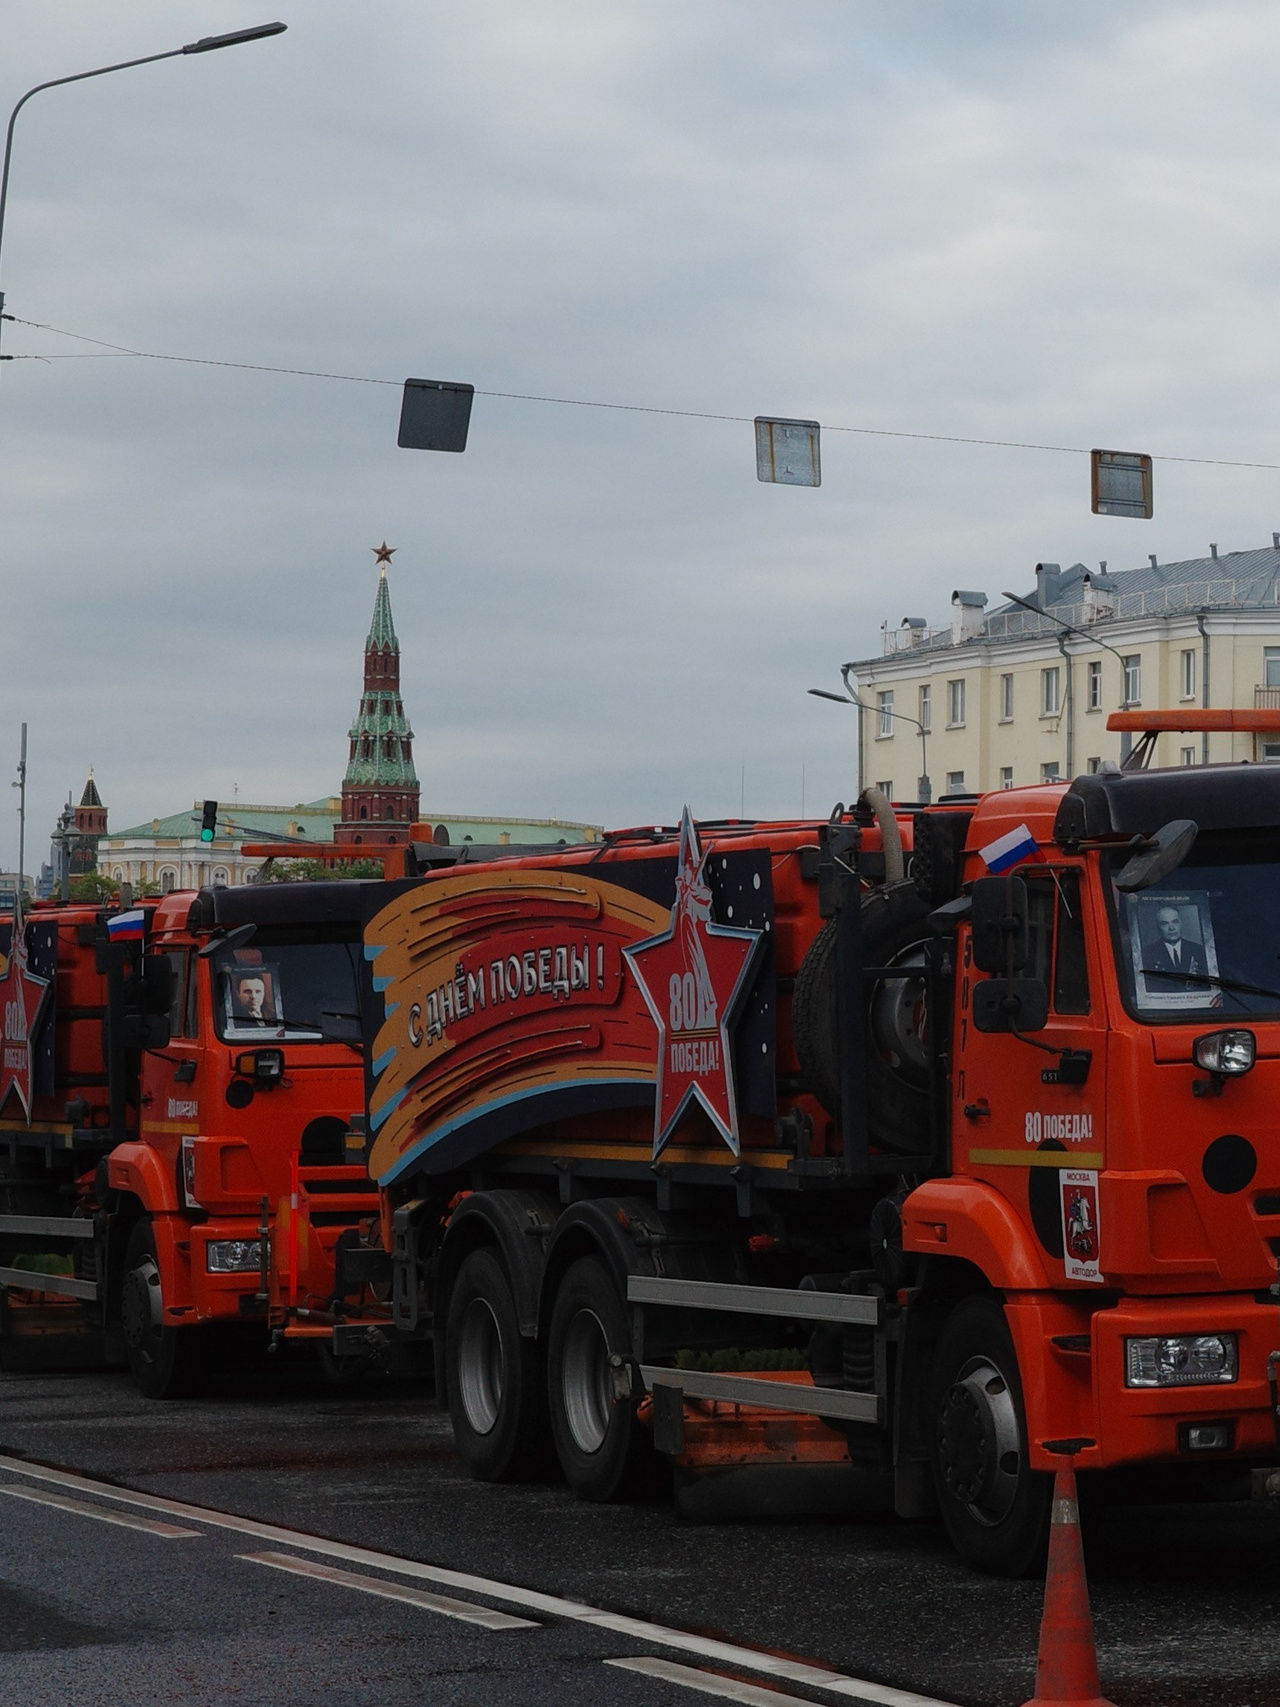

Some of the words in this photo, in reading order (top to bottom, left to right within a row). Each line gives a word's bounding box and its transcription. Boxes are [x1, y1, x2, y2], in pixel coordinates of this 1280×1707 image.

[407, 1003, 423, 1048] С
[426, 962, 486, 1046] ДНЁМ
[669, 971, 696, 1031] 80
[670, 1040, 720, 1077] ПОБЕДА!
[1025, 1111, 1042, 1143] 80
[1043, 1114, 1093, 1143] ПОБЕДА!
[1066, 1172, 1091, 1182] МОСКВА
[1071, 1266, 1098, 1278] АВТОДОР
